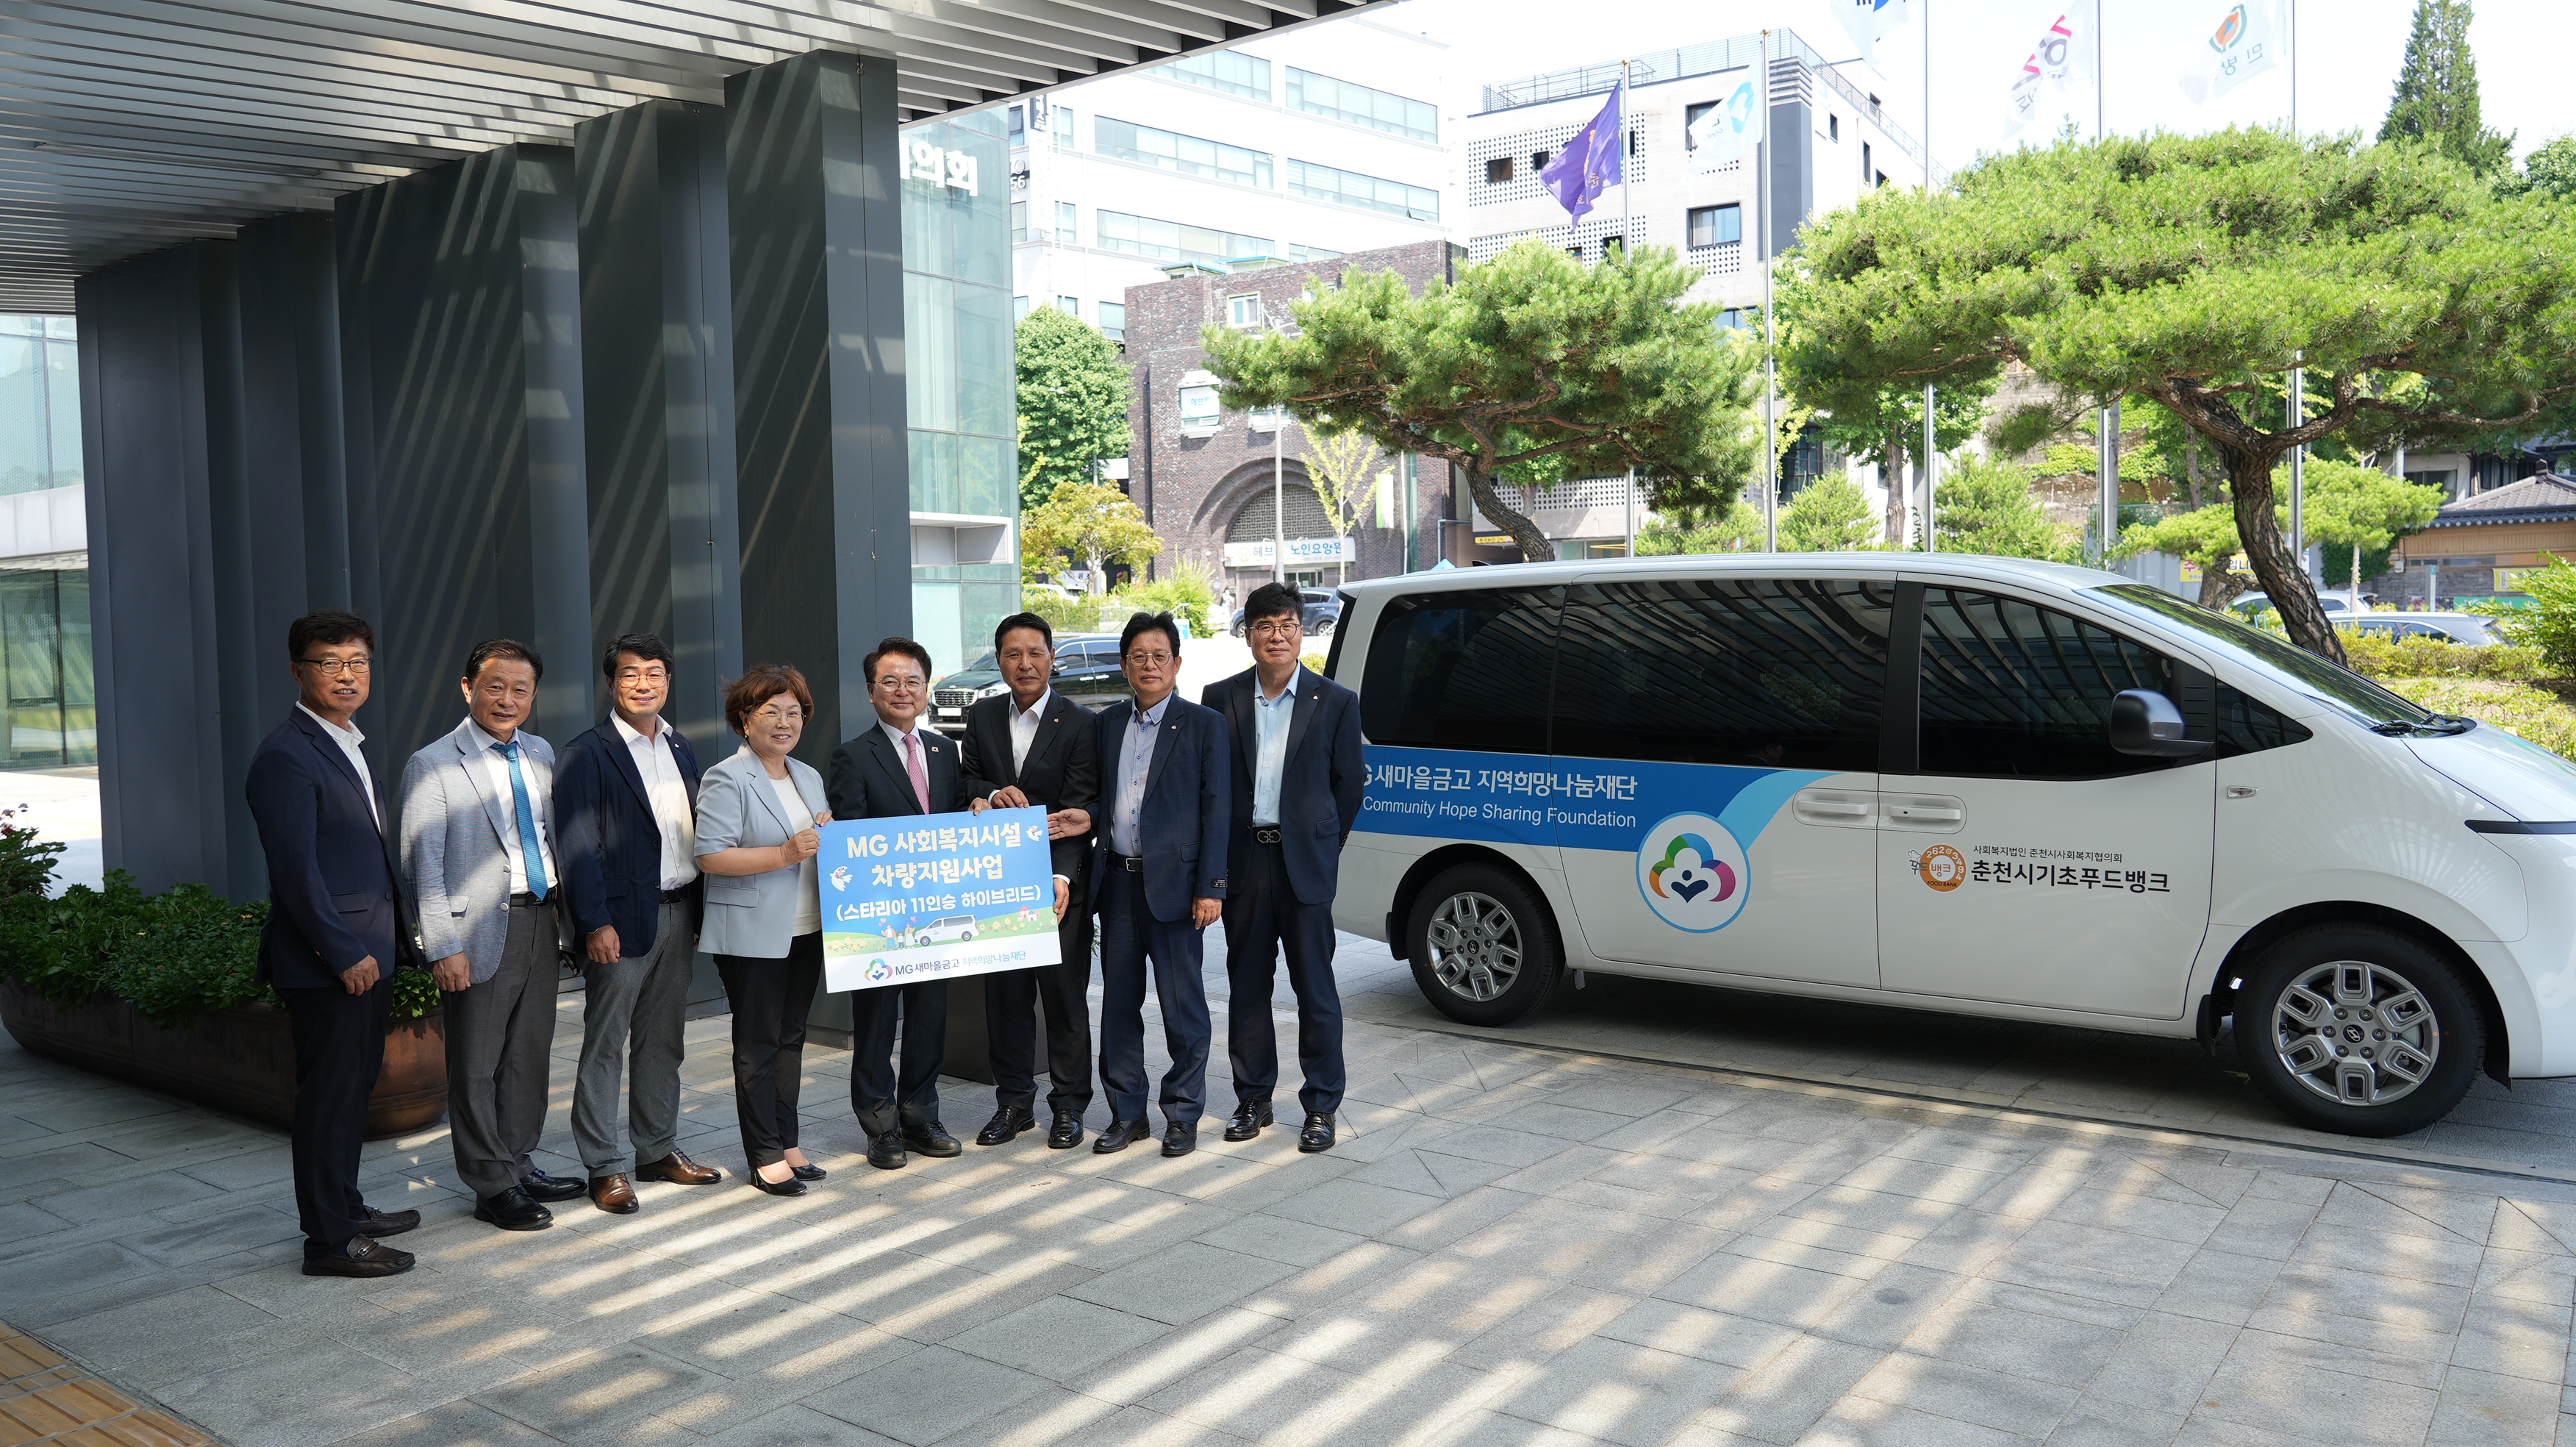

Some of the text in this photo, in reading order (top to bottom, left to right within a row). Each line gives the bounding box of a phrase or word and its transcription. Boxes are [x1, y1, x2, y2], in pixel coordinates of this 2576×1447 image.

[1253, 546, 1275, 557] 헤브
[1477, 770, 1638, 801] 지역희망나눔재단
[1363, 796, 1636, 828] Community Hope Sharing Foundation
[847, 822, 1022, 859] MG 사회복지시설
[1973, 844, 2123, 864] 사회복지법인 춘천시사회복지협의회
[871, 854, 1004, 889] 차량지원사업
[1931, 863, 1951, 877] 뱅크
[1970, 860, 2171, 894] 춘천시기초푸드뱅크
[837, 885, 1042, 922] (스타리아 11인승 하이브리드)
[962, 950, 1027, 967] 지역희망나눔재단
